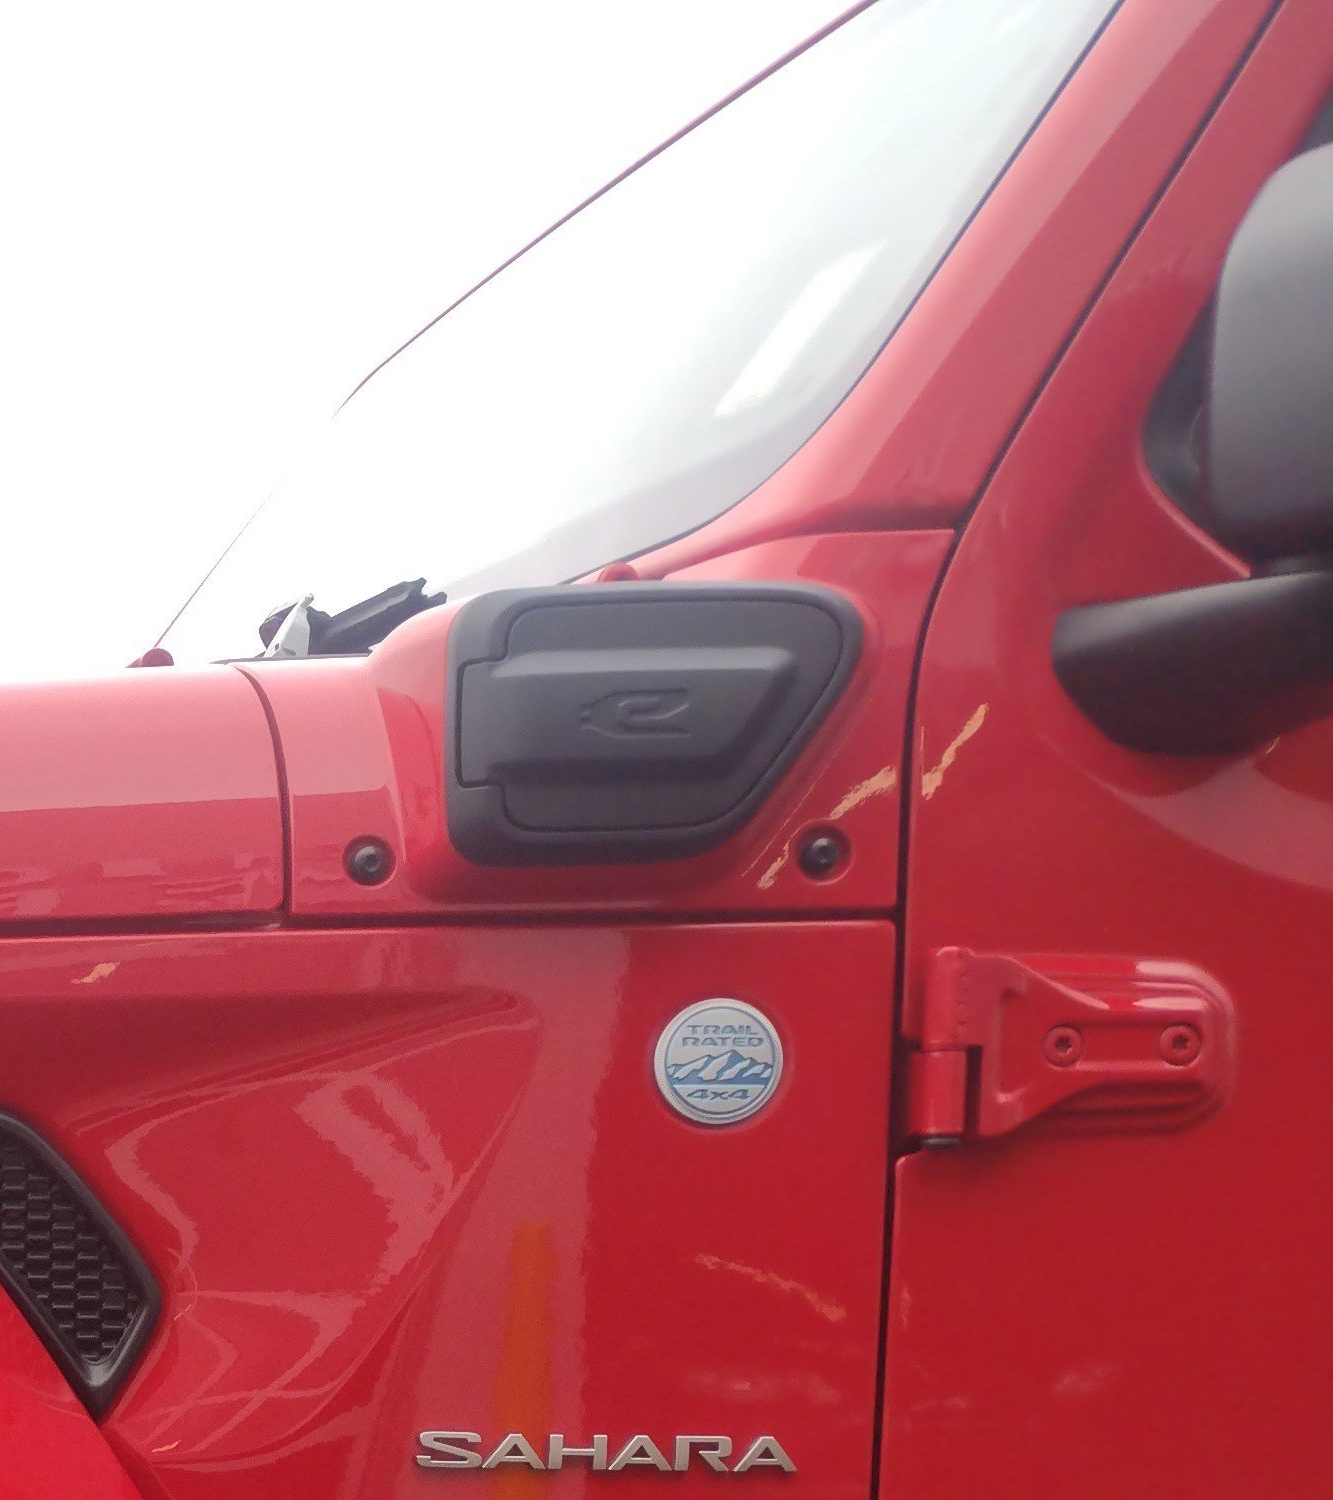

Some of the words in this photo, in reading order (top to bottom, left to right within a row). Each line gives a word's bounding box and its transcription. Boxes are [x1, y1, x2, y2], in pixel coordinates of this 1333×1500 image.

[686, 1024, 758, 1035] TRAIL
[682, 1036, 764, 1047] RATED
[414, 1429, 796, 1473] SAHARA
